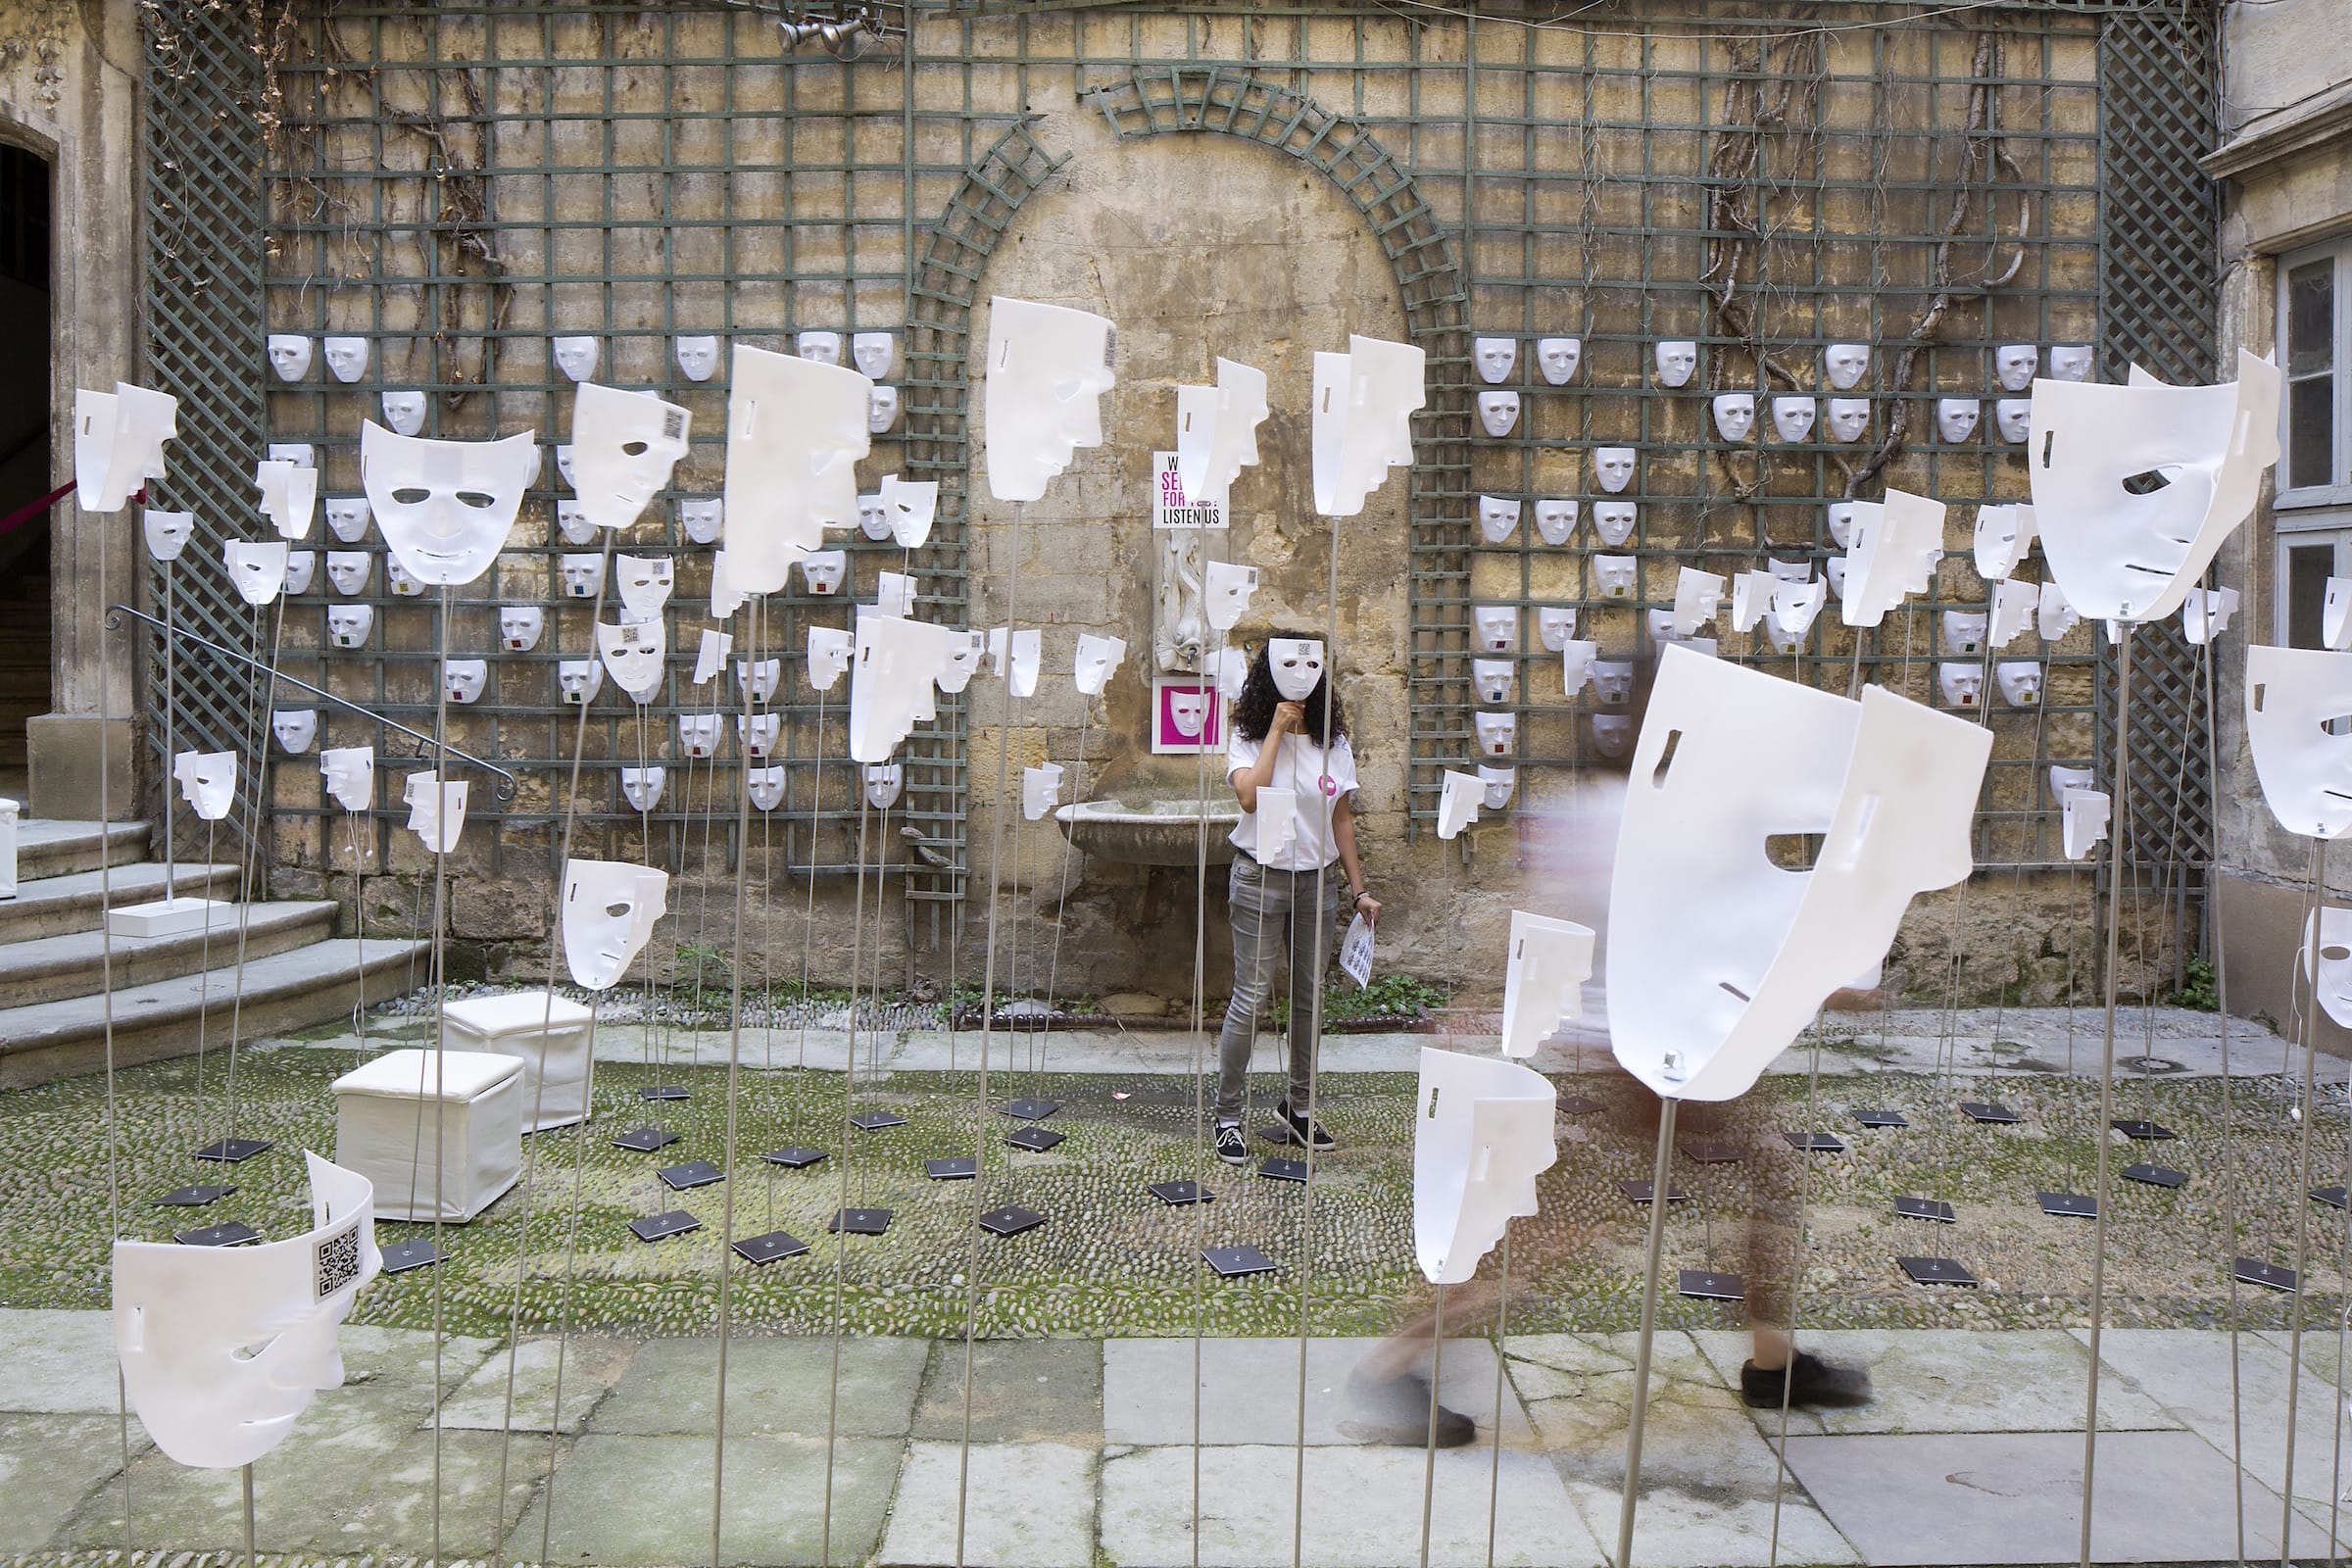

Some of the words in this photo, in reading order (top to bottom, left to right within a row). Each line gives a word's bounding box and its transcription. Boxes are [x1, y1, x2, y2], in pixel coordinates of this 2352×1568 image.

[1163, 492, 1185, 507] FOR
[1163, 509, 1200, 524] LISTEN
[1204, 509, 1219, 524] US
